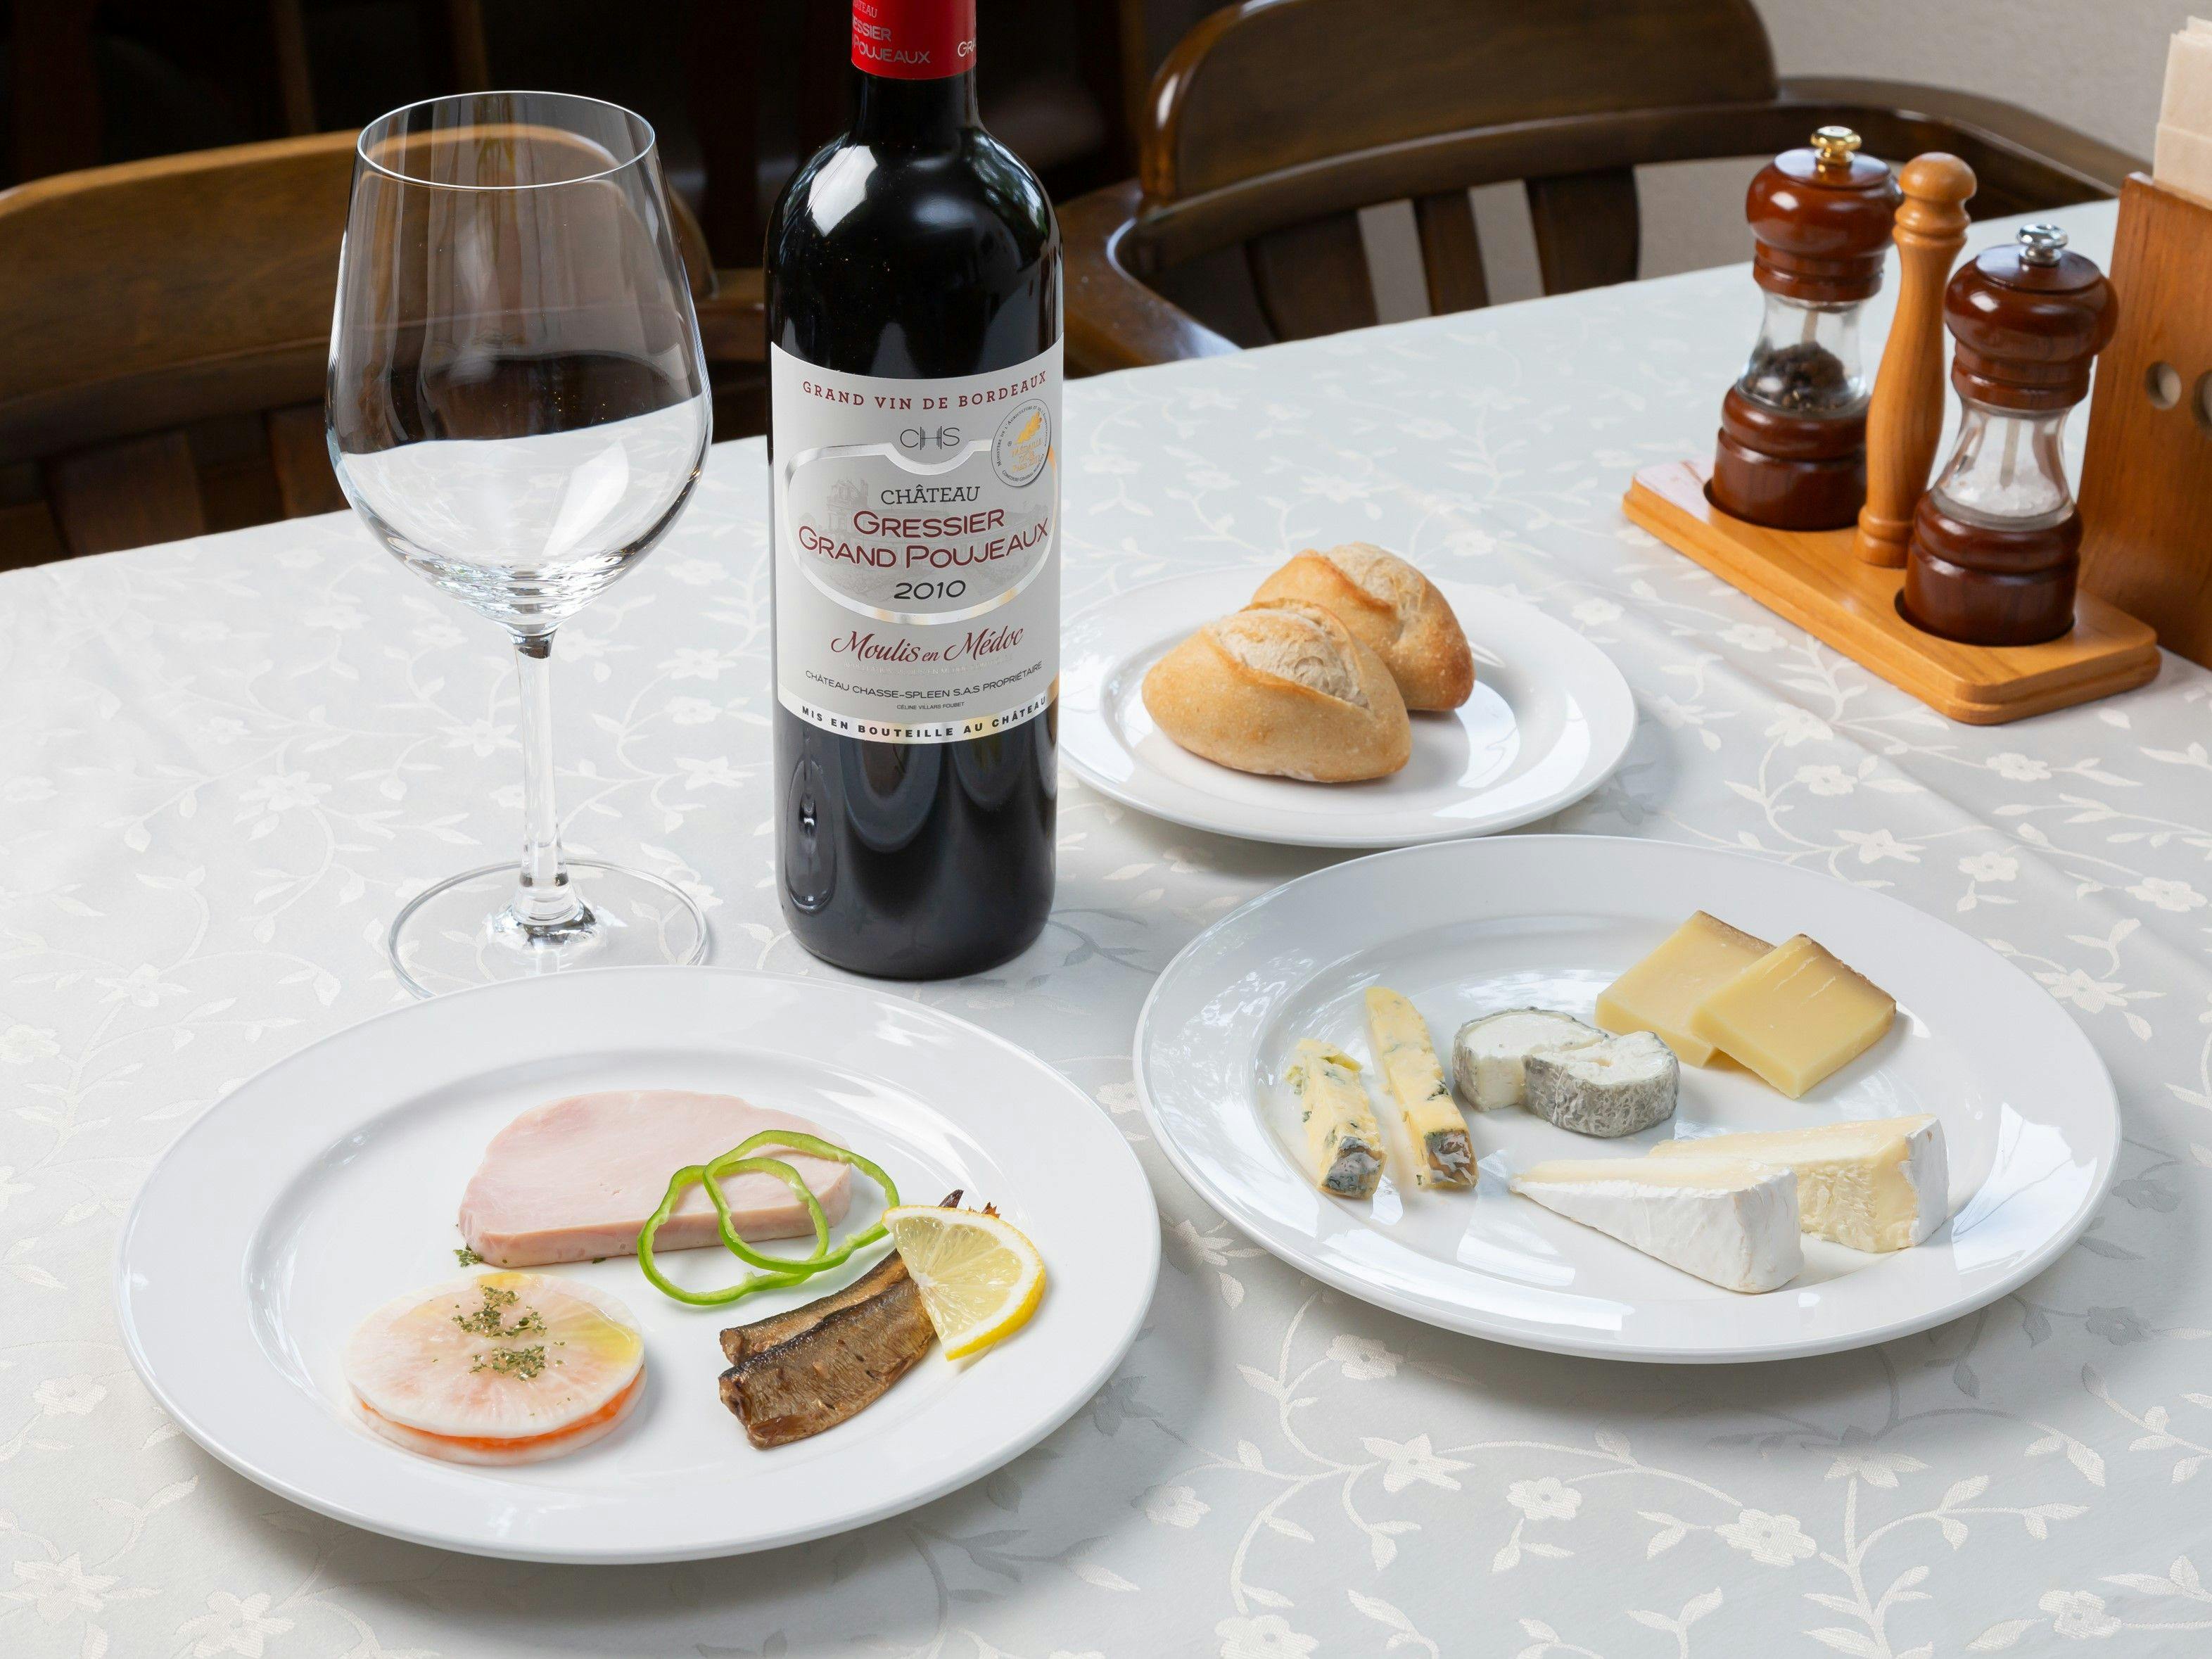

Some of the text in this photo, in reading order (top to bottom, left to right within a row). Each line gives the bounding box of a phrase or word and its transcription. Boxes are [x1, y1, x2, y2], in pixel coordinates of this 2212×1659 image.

[802, 370, 1047, 409] GRAND VIN DE BORDEAUX
[900, 426, 960, 450] CHS
[881, 484, 980, 504] CHÂTEAU
[853, 509, 1005, 538] GRESSIER
[799, 517, 1048, 568] GRAND POUJEAUX
[894, 580, 965, 599] 2010
[831, 625, 1024, 662] Moulis en Médoc
[806, 670, 850, 692] CHÂTEAU
[852, 685, 950, 699] CHASSE-SPLEEN
[983, 661, 1043, 691] PROPRIÉTAIRE
[801, 696, 1047, 737] MIS EN BOUTEILLE AU CHÂTEAU
